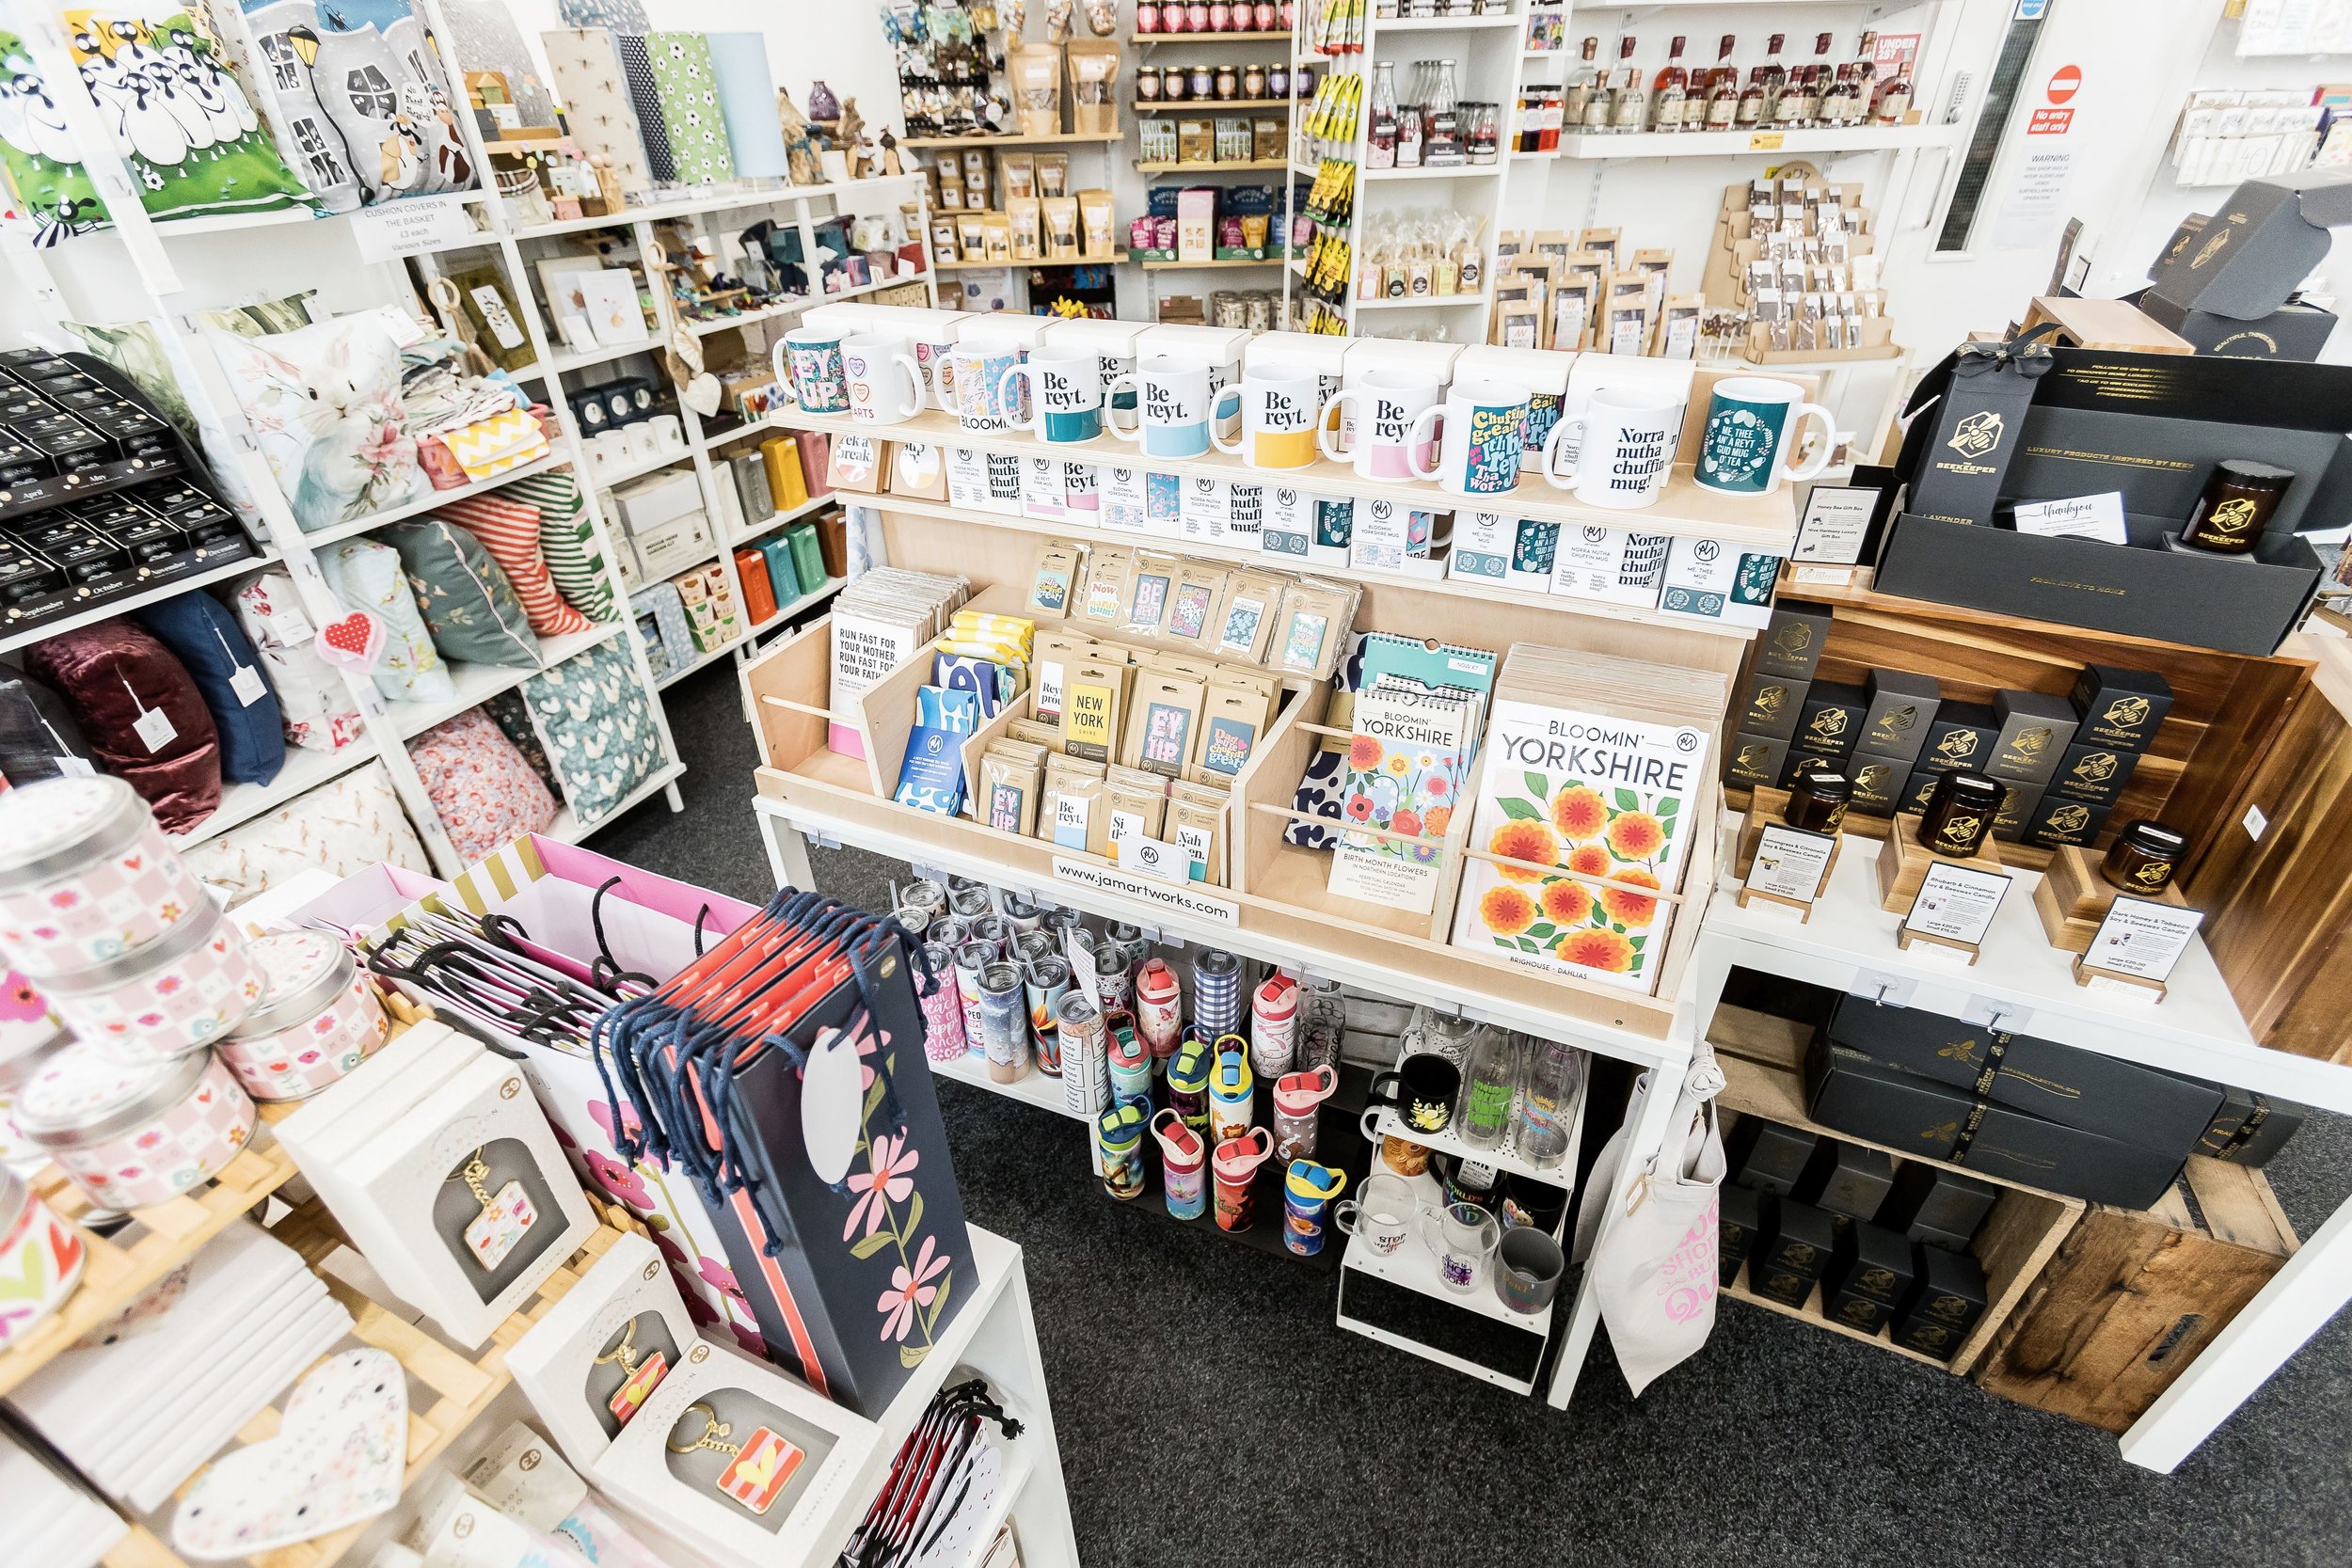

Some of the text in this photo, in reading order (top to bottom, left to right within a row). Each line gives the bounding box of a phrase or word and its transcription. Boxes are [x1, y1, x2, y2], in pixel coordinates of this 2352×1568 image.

[1879, 38, 1917, 49] UNDER
[2035, 110, 2071, 121] No entry
[2029, 122, 2067, 134] staff only
[2031, 154, 2070, 163] WARNING
[364, 205, 404, 218] CUSHION
[405, 201, 437, 213] COVERS
[385, 214, 435, 228] THE BASKET
[411, 228, 430, 237] each
[391, 237, 442, 252] Various Sizes
[793, 349, 832, 381] EY
[1042, 372, 1068, 390] Be
[799, 381, 837, 409] UP
[1045, 388, 1086, 411] reyt.
[1146, 382, 1169, 402] Be
[1265, 390, 1291, 410] Be
[1147, 402, 1188, 423] reyt.
[1376, 399, 1405, 420] Be
[1264, 407, 1307, 431] reyt.
[1471, 420, 1519, 445] great!
[1618, 427, 1665, 444] Norra
[1735, 428, 1755, 439] THEE
[1716, 434, 1756, 449] AN' A REYT
[1615, 442, 1662, 458] nutha
[1716, 445, 1750, 459] GUD MUG
[2026, 446, 2063, 455] LUXURY
[2063, 450, 2110, 460] PRODUCTS
[2111, 454, 2154, 466] INSPIRED
[150, 457, 167, 467] June
[1064, 462, 1084, 475] Be
[1613, 458, 1664, 476] chuffin
[1719, 454, 1741, 467] O' TEA
[1935, 462, 1996, 475] BEEKEEPER
[89, 473, 107, 483] May
[1475, 464, 1500, 481] Tha
[1064, 474, 1099, 493] reyt.
[1470, 478, 1502, 492] Wot?
[1610, 475, 1652, 494] mug!
[22, 488, 44, 500] April
[991, 487, 1021, 500] mug!
[1231, 520, 1262, 534] mug!
[1626, 532, 1666, 547] Norra
[2198, 531, 2246, 545] BEEKEEPER
[207, 541, 242, 557] December
[1570, 546, 1611, 557] NORRA NUTHA
[1571, 552, 1594, 561] CHUFFIN
[1623, 546, 1663, 560] nutha
[149, 560, 187, 576] November
[92, 580, 124, 594] October
[1618, 572, 1655, 588] mug!
[1092, 583, 1117, 595] Now
[1137, 581, 1164, 606] BE
[21, 599, 65, 617] September
[1089, 605, 1115, 616] bum!
[839, 627, 897, 650] RUN FAST FOR
[839, 640, 898, 664] YOUR MOTHER,
[839, 651, 878, 670] RUN FAST
[839, 662, 860, 677] YOUR
[1076, 694, 1104, 711] NEW
[1073, 712, 1104, 730] YORK
[1152, 710, 1184, 740] EY
[1384, 711, 1432, 726] BLOOMIN'
[1078, 729, 1097, 737] SHIRE
[1215, 728, 1238, 744] Dad
[1361, 718, 1454, 748] YORKSHIRE
[1549, 720, 1646, 750] BLOOMIN'
[2092, 726, 2142, 739] BEEKEEPER
[1146, 735, 1180, 762] UP
[1208, 752, 1246, 771] great!
[1502, 733, 1690, 792] YORKSHIRE
[1930, 756, 1973, 768] BEEKEEPER
[2062, 780, 2110, 794] BEEKEEPER
[995, 788, 1018, 811] EY
[1058, 800, 1074, 814] Be
[992, 809, 1016, 831] UP
[1057, 809, 1084, 826] reyt.
[1112, 816, 1124, 830] Si
[1178, 831, 1202, 847] Nah
[1762, 836, 1794, 847] Lemongrass
[1799, 844, 1827, 856] Citronella
[1778, 846, 1803, 856] Beeswax
[1803, 850, 1822, 860] Candle
[1343, 853, 1428, 877] BIRTH MONTH FLOWERS
[1359, 865, 1387, 875] NORTHERN
[1387, 871, 1416, 881] LOCATIONS
[1057, 863, 1230, 920] www.jamartworks.com
[1764, 880, 1777, 889] Large
[1926, 882, 1937, 891] Soy
[1944, 885, 1970, 896] Beeswax
[1970, 891, 1995, 900] Candle
[1930, 877, 1956, 887] Rhubarb
[1963, 882, 1996, 895] Cinnamon
[1927, 919, 1941, 927] Large
[2129, 914, 2152, 923] Honey
[2160, 920, 2190, 929] Tobacco
[2130, 920, 2160, 930] Beeswax
[2161, 927, 2186, 935] Candle
[1509, 956, 1588, 980] BRIGHOUSE DAHLIAS
[501, 1079, 520, 1099] £9
[1445, 1176, 1484, 1203] WORLD'S
[1378, 1232, 1406, 1243] STOP
[644, 1259, 660, 1280] £9
[691, 1345, 708, 1363] £9
